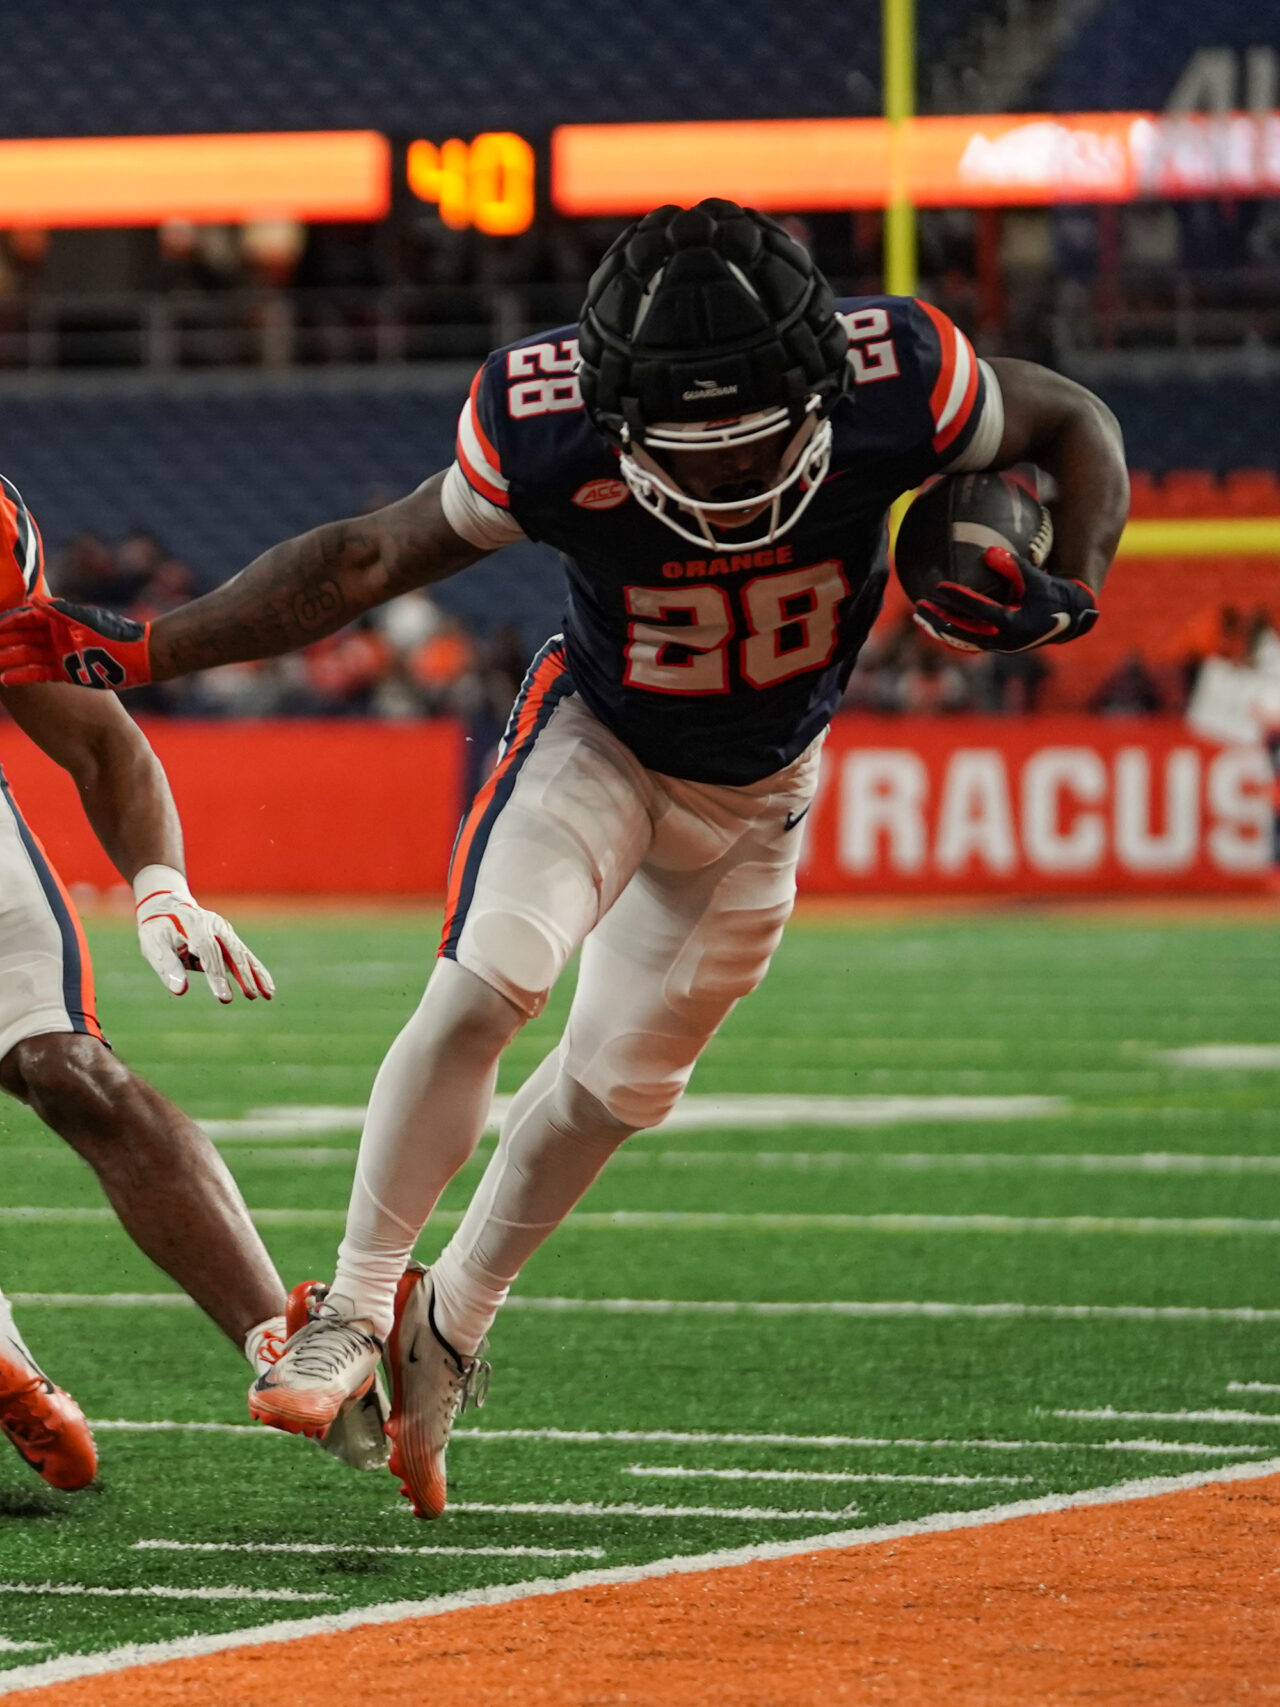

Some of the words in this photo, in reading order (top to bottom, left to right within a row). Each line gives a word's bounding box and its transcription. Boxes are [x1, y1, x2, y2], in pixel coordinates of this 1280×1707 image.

[407, 132, 535, 236] 40
[506, 338, 586, 420] 28
[682, 384, 739, 401] GUARDIAN
[584, 483, 622, 503] ACC
[662, 545, 793, 579] ORANGE
[622, 559, 851, 697] 28
